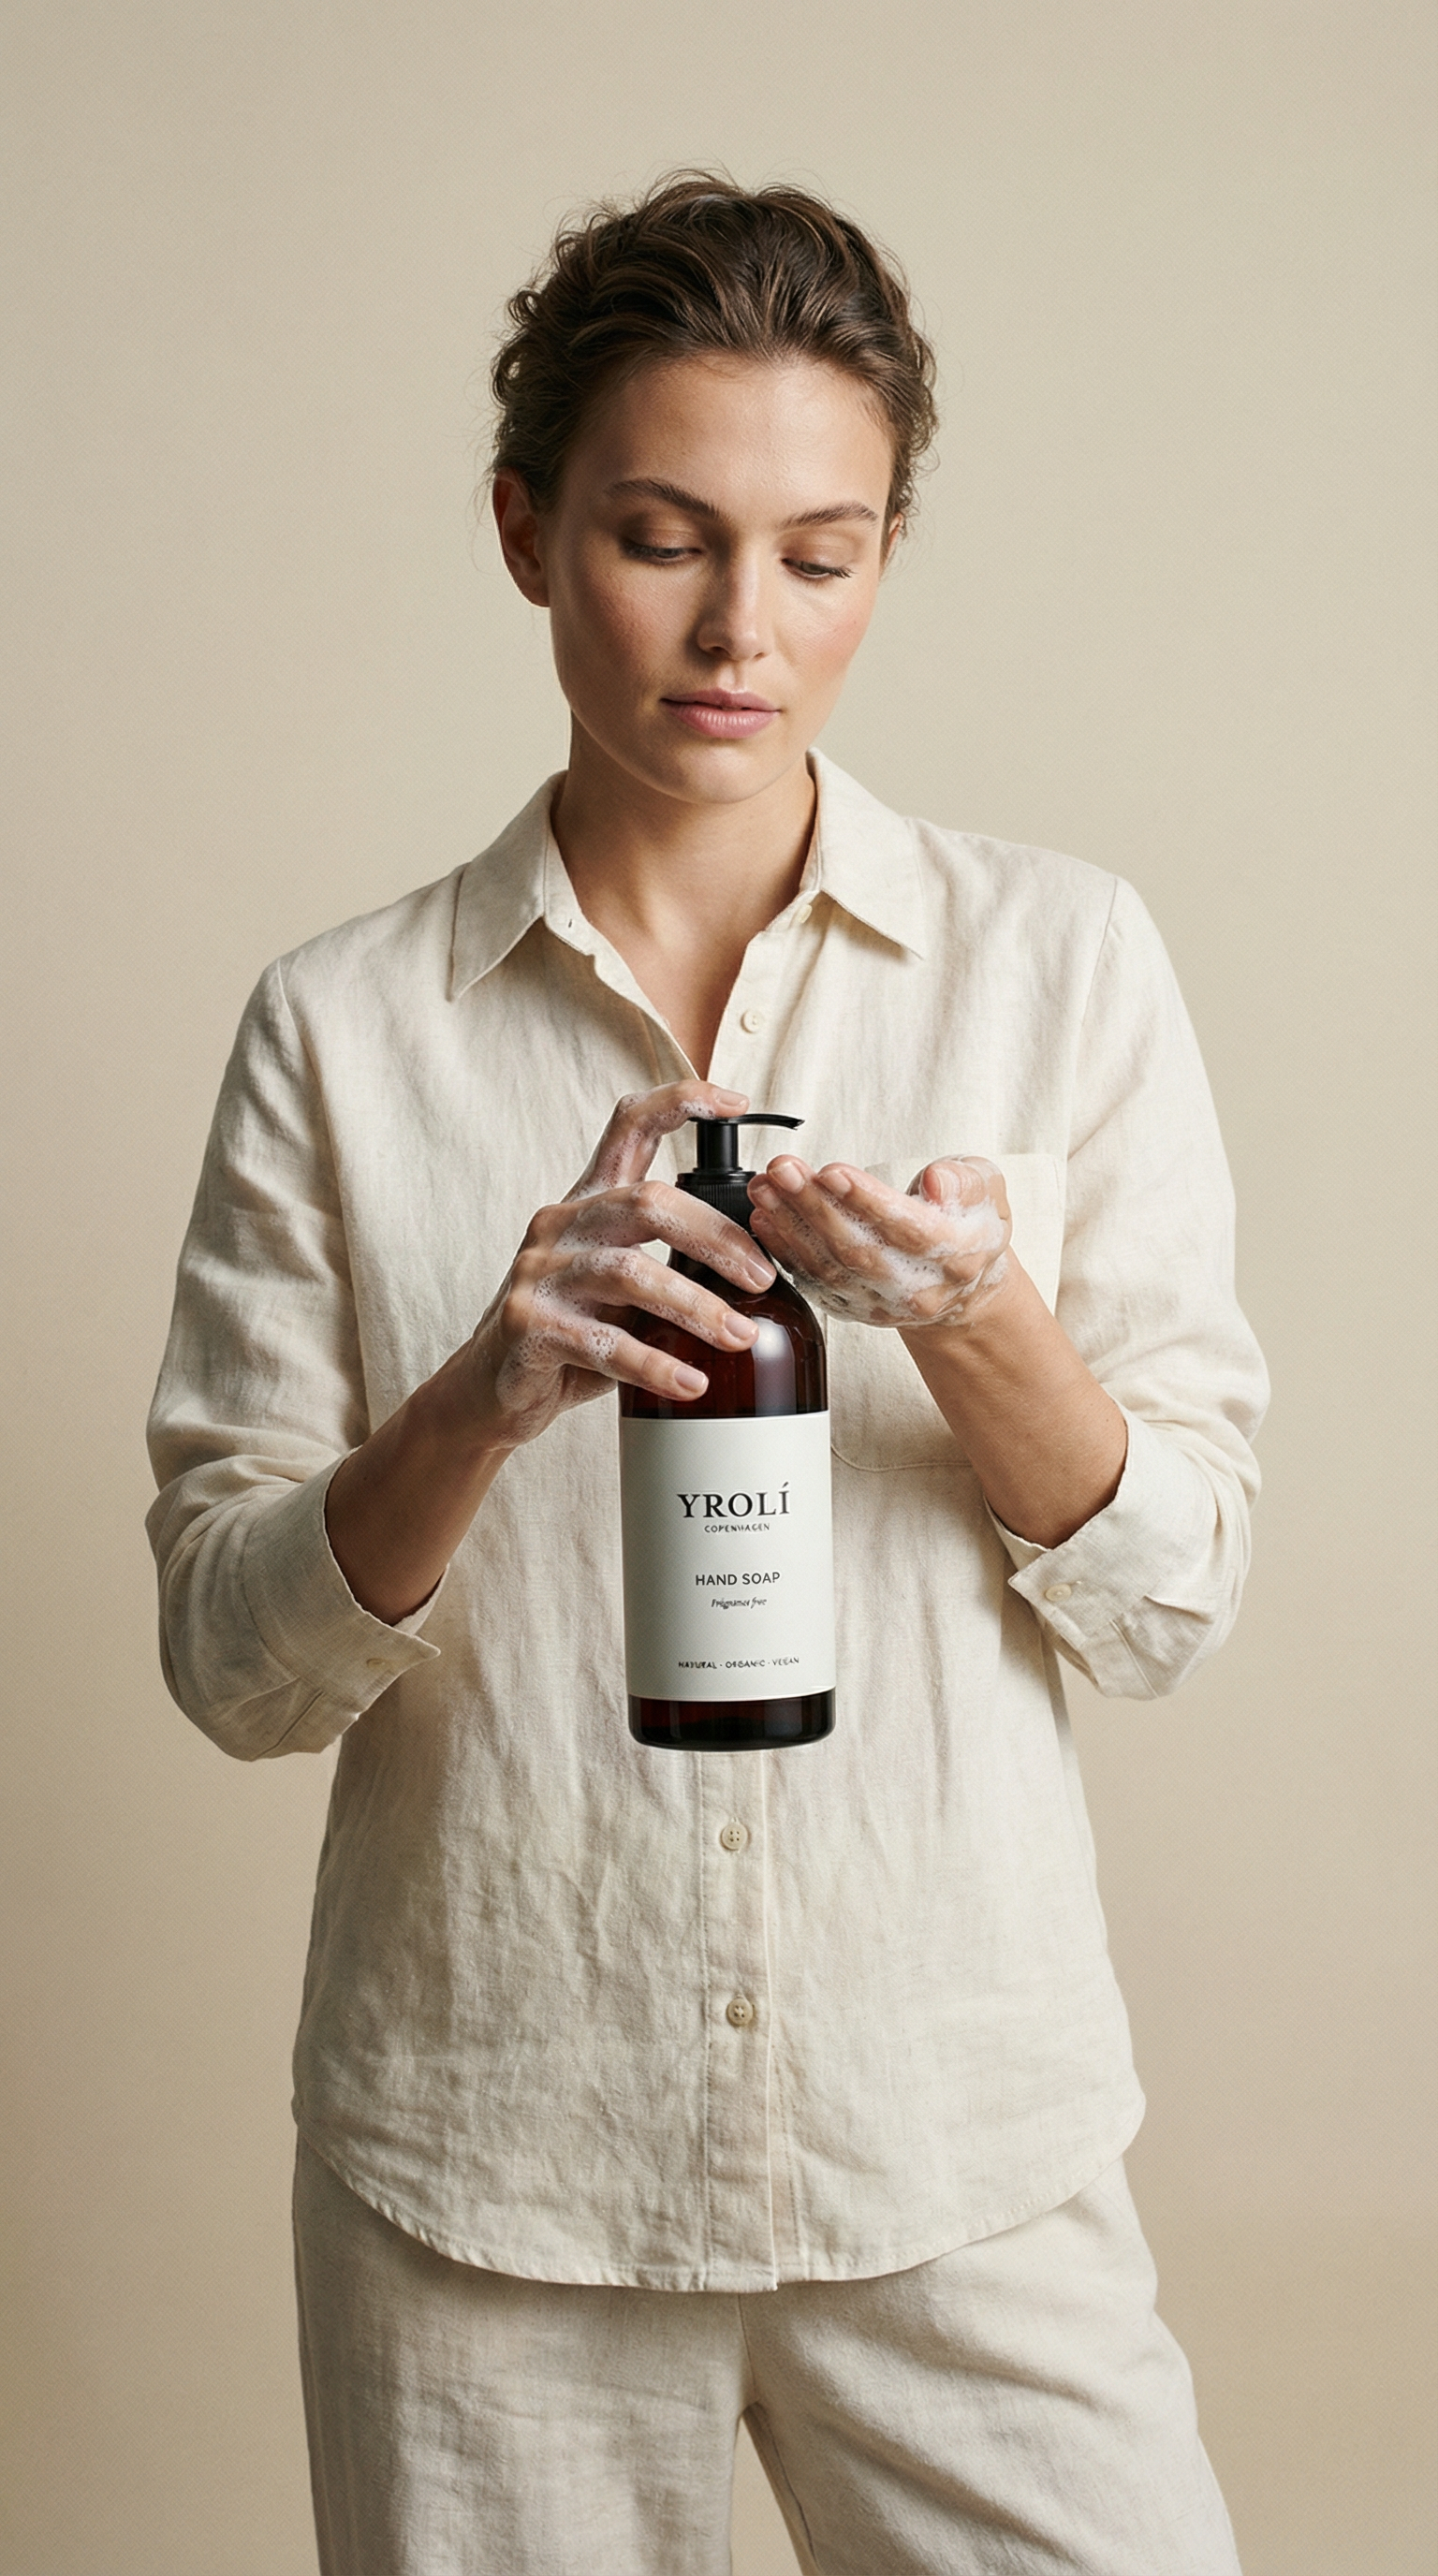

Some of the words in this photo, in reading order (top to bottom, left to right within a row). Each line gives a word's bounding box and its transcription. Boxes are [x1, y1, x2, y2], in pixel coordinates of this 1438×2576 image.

[677, 1482, 790, 1518] YROLÍ
[696, 1573, 738, 1586] HAND
[741, 1572, 781, 1585] SOAP
